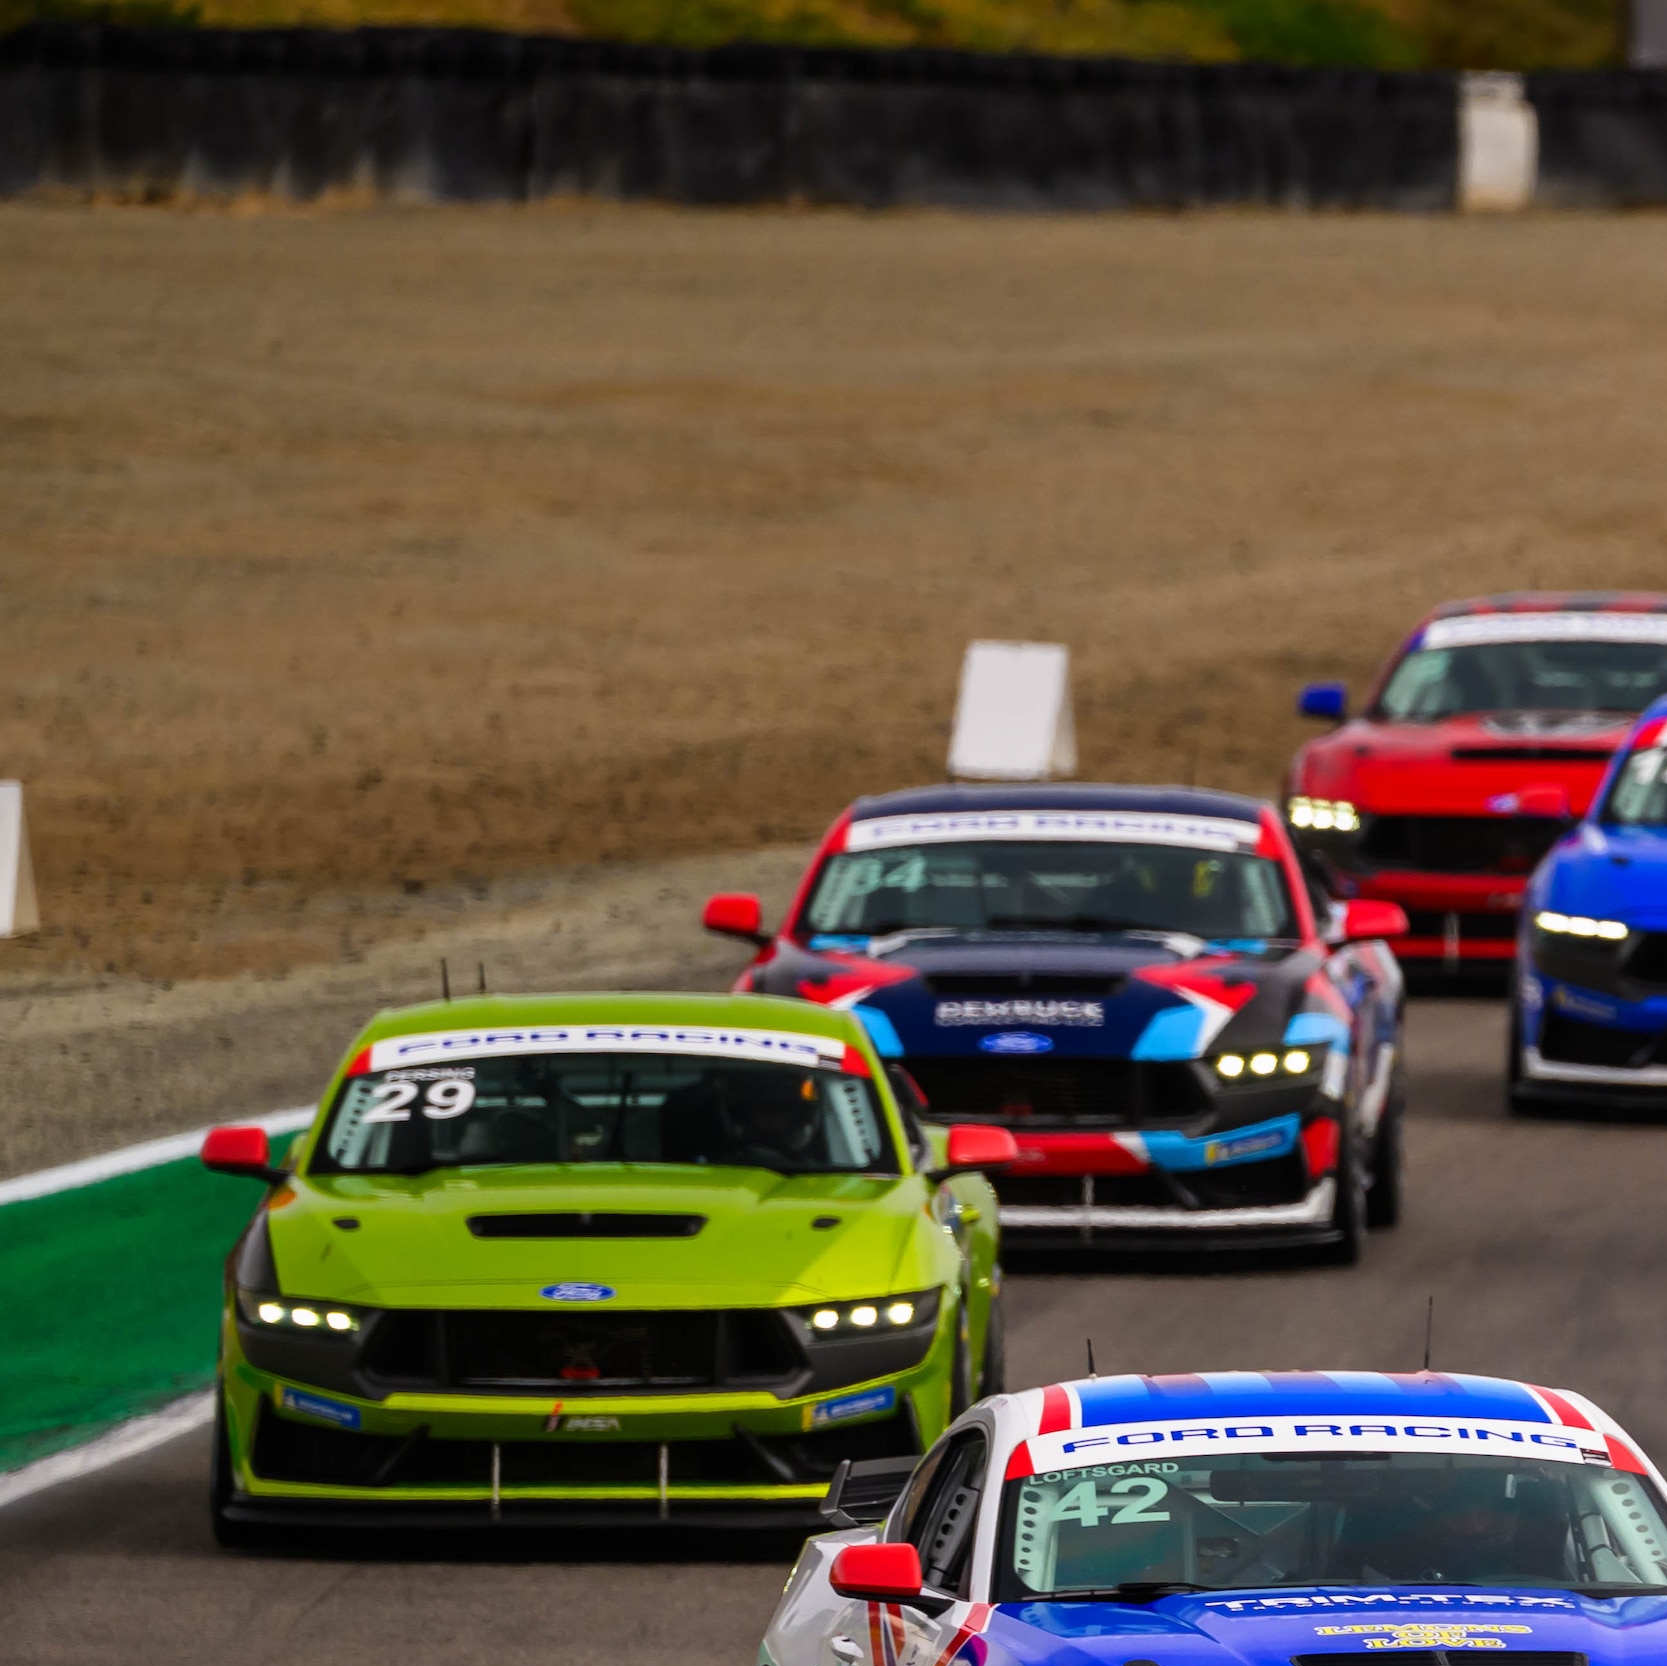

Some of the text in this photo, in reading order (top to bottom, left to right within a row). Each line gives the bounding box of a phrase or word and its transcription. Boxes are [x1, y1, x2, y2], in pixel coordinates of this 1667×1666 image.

[399, 1029, 818, 1055] FORD RACING
[362, 1079, 476, 1123] 29
[1062, 1424, 1581, 1454] FORD RACING
[1029, 1461, 1180, 1486] LOFTSGARD
[1045, 1475, 1172, 1528] 42
[1205, 1594, 1571, 1609] TRIM-TEX
[1314, 1623, 1533, 1636] LEMONS
[1363, 1638, 1506, 1649] LOVE
